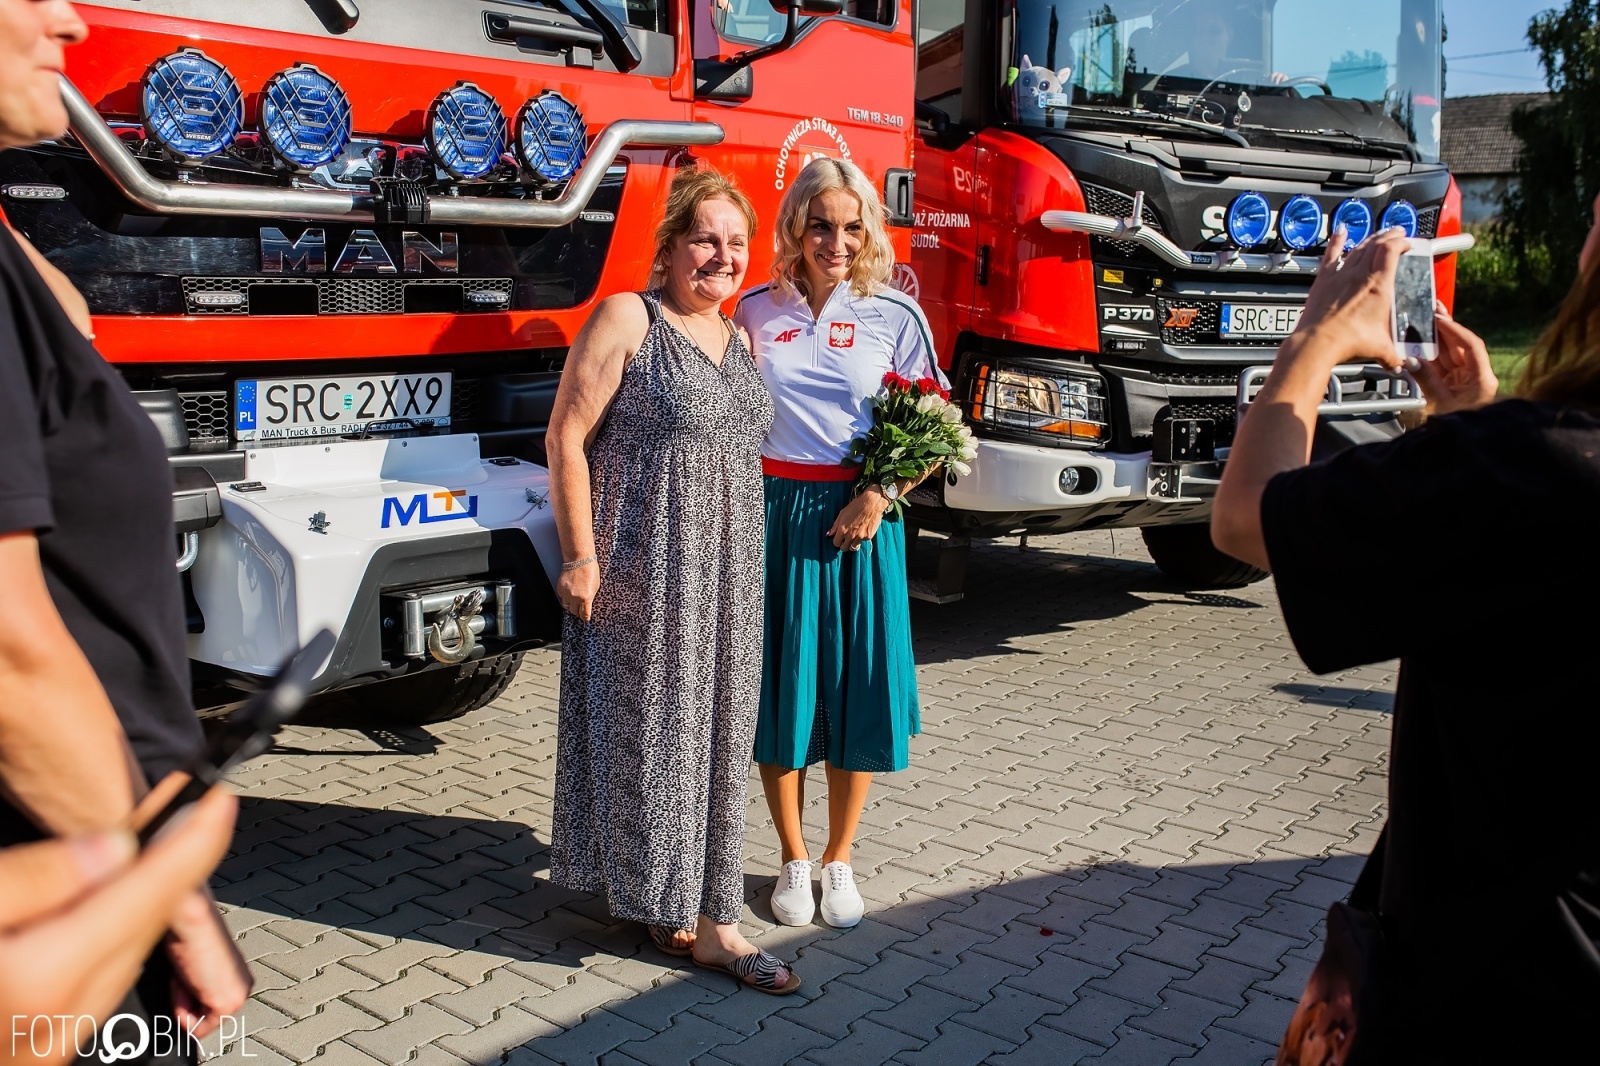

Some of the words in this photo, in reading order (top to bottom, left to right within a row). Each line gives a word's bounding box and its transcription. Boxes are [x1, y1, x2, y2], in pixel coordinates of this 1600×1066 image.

[847, 107, 869, 122] TGM
[869, 111, 904, 128] 18.340
[185, 133, 212, 141] WESEM
[299, 143, 324, 151] WESEM
[775, 119, 812, 190] OCHOTNICZA
[836, 133, 853, 163] POŻ
[928, 209, 971, 228] POŻARNA
[911, 231, 940, 249] SUDÓŁ
[260, 227, 460, 274] MAN
[1104, 307, 1117, 320] P
[1118, 308, 1155, 321] 370
[1163, 308, 1198, 328] XT
[1233, 308, 1269, 331] SRC
[1275, 309, 1305, 332] EF
[265, 382, 341, 424] SRC
[355, 377, 443, 419] 2XX9
[239, 411, 254, 422] PL
[261, 429, 283, 438] MAN
[285, 427, 309, 437] Truck
[311, 426, 318, 435] &
[320, 425, 337, 434] Bus
